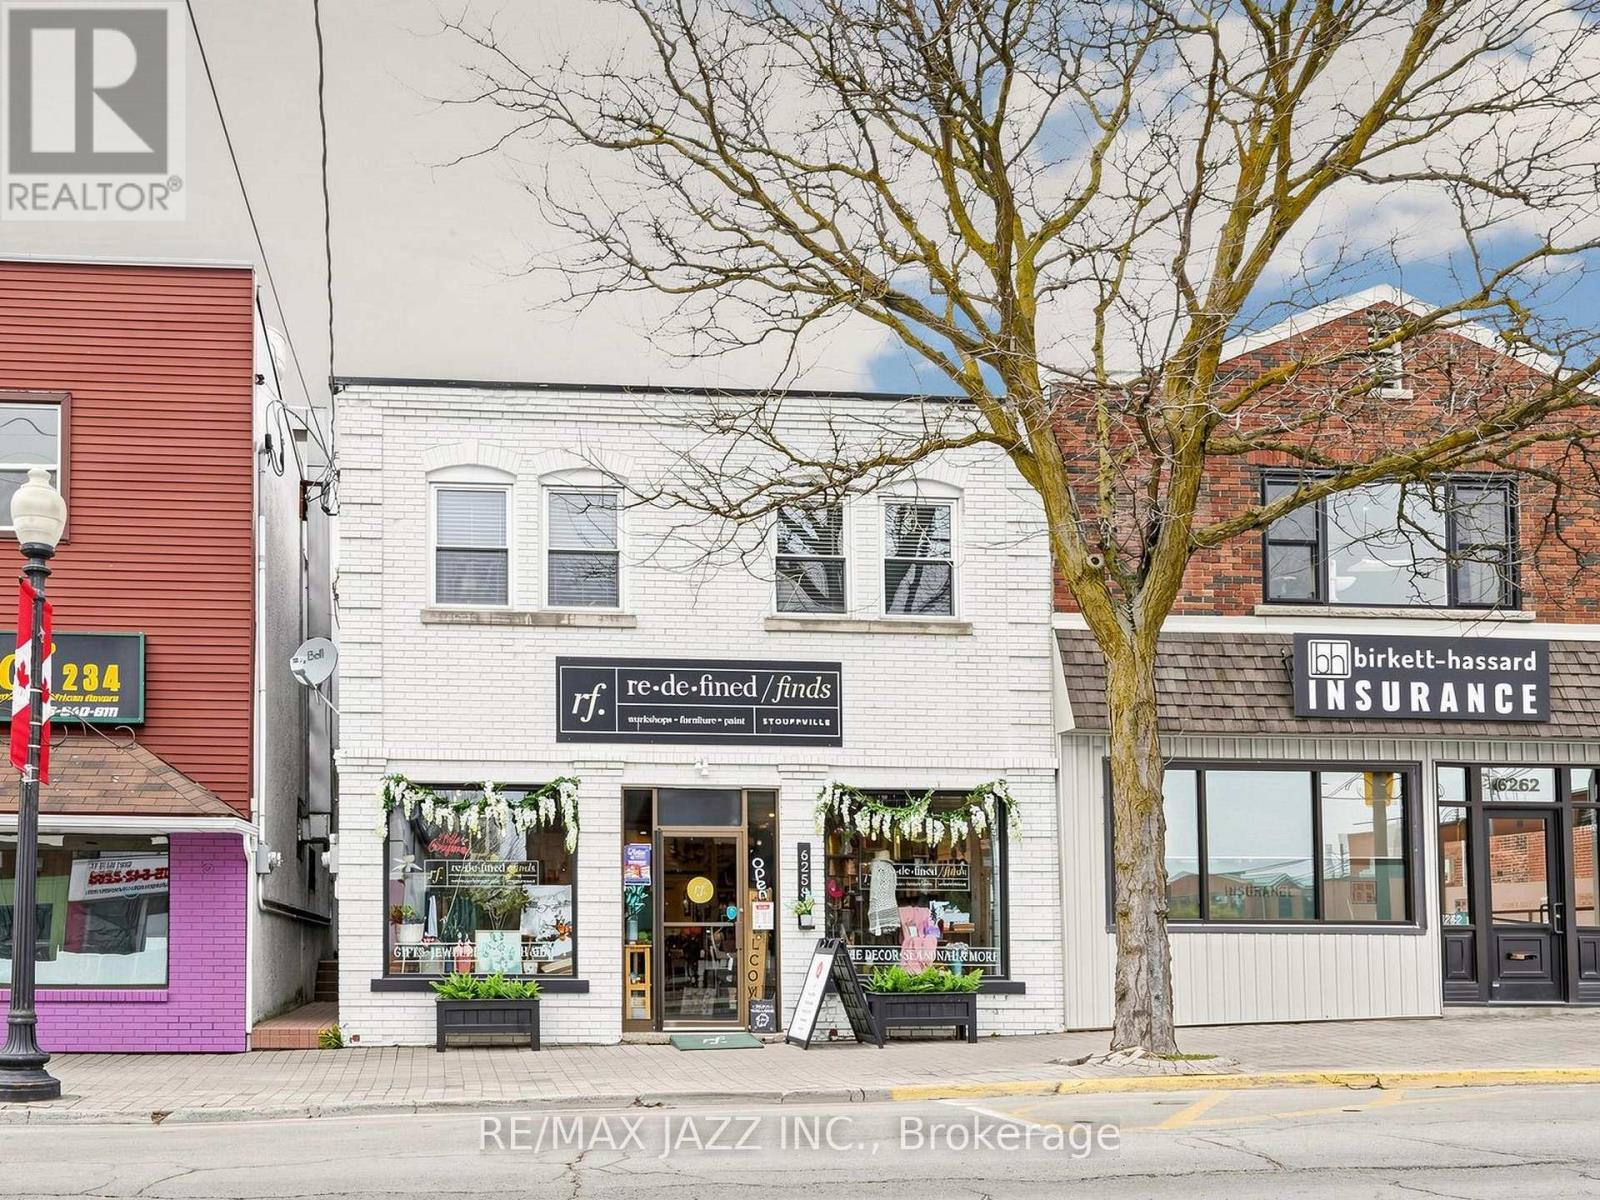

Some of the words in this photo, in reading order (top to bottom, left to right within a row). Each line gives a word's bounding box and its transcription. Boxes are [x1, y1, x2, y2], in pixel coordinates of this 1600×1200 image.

[307, 648, 325, 661] Bell
[1355, 647, 1537, 671] birkett-hassard
[62, 663, 121, 692] 234
[1308, 679, 1538, 714] INSURANCE
[724, 716, 745, 726] paint
[1497, 777, 1541, 791] 6262
[865, 949, 900, 961] DECOR
